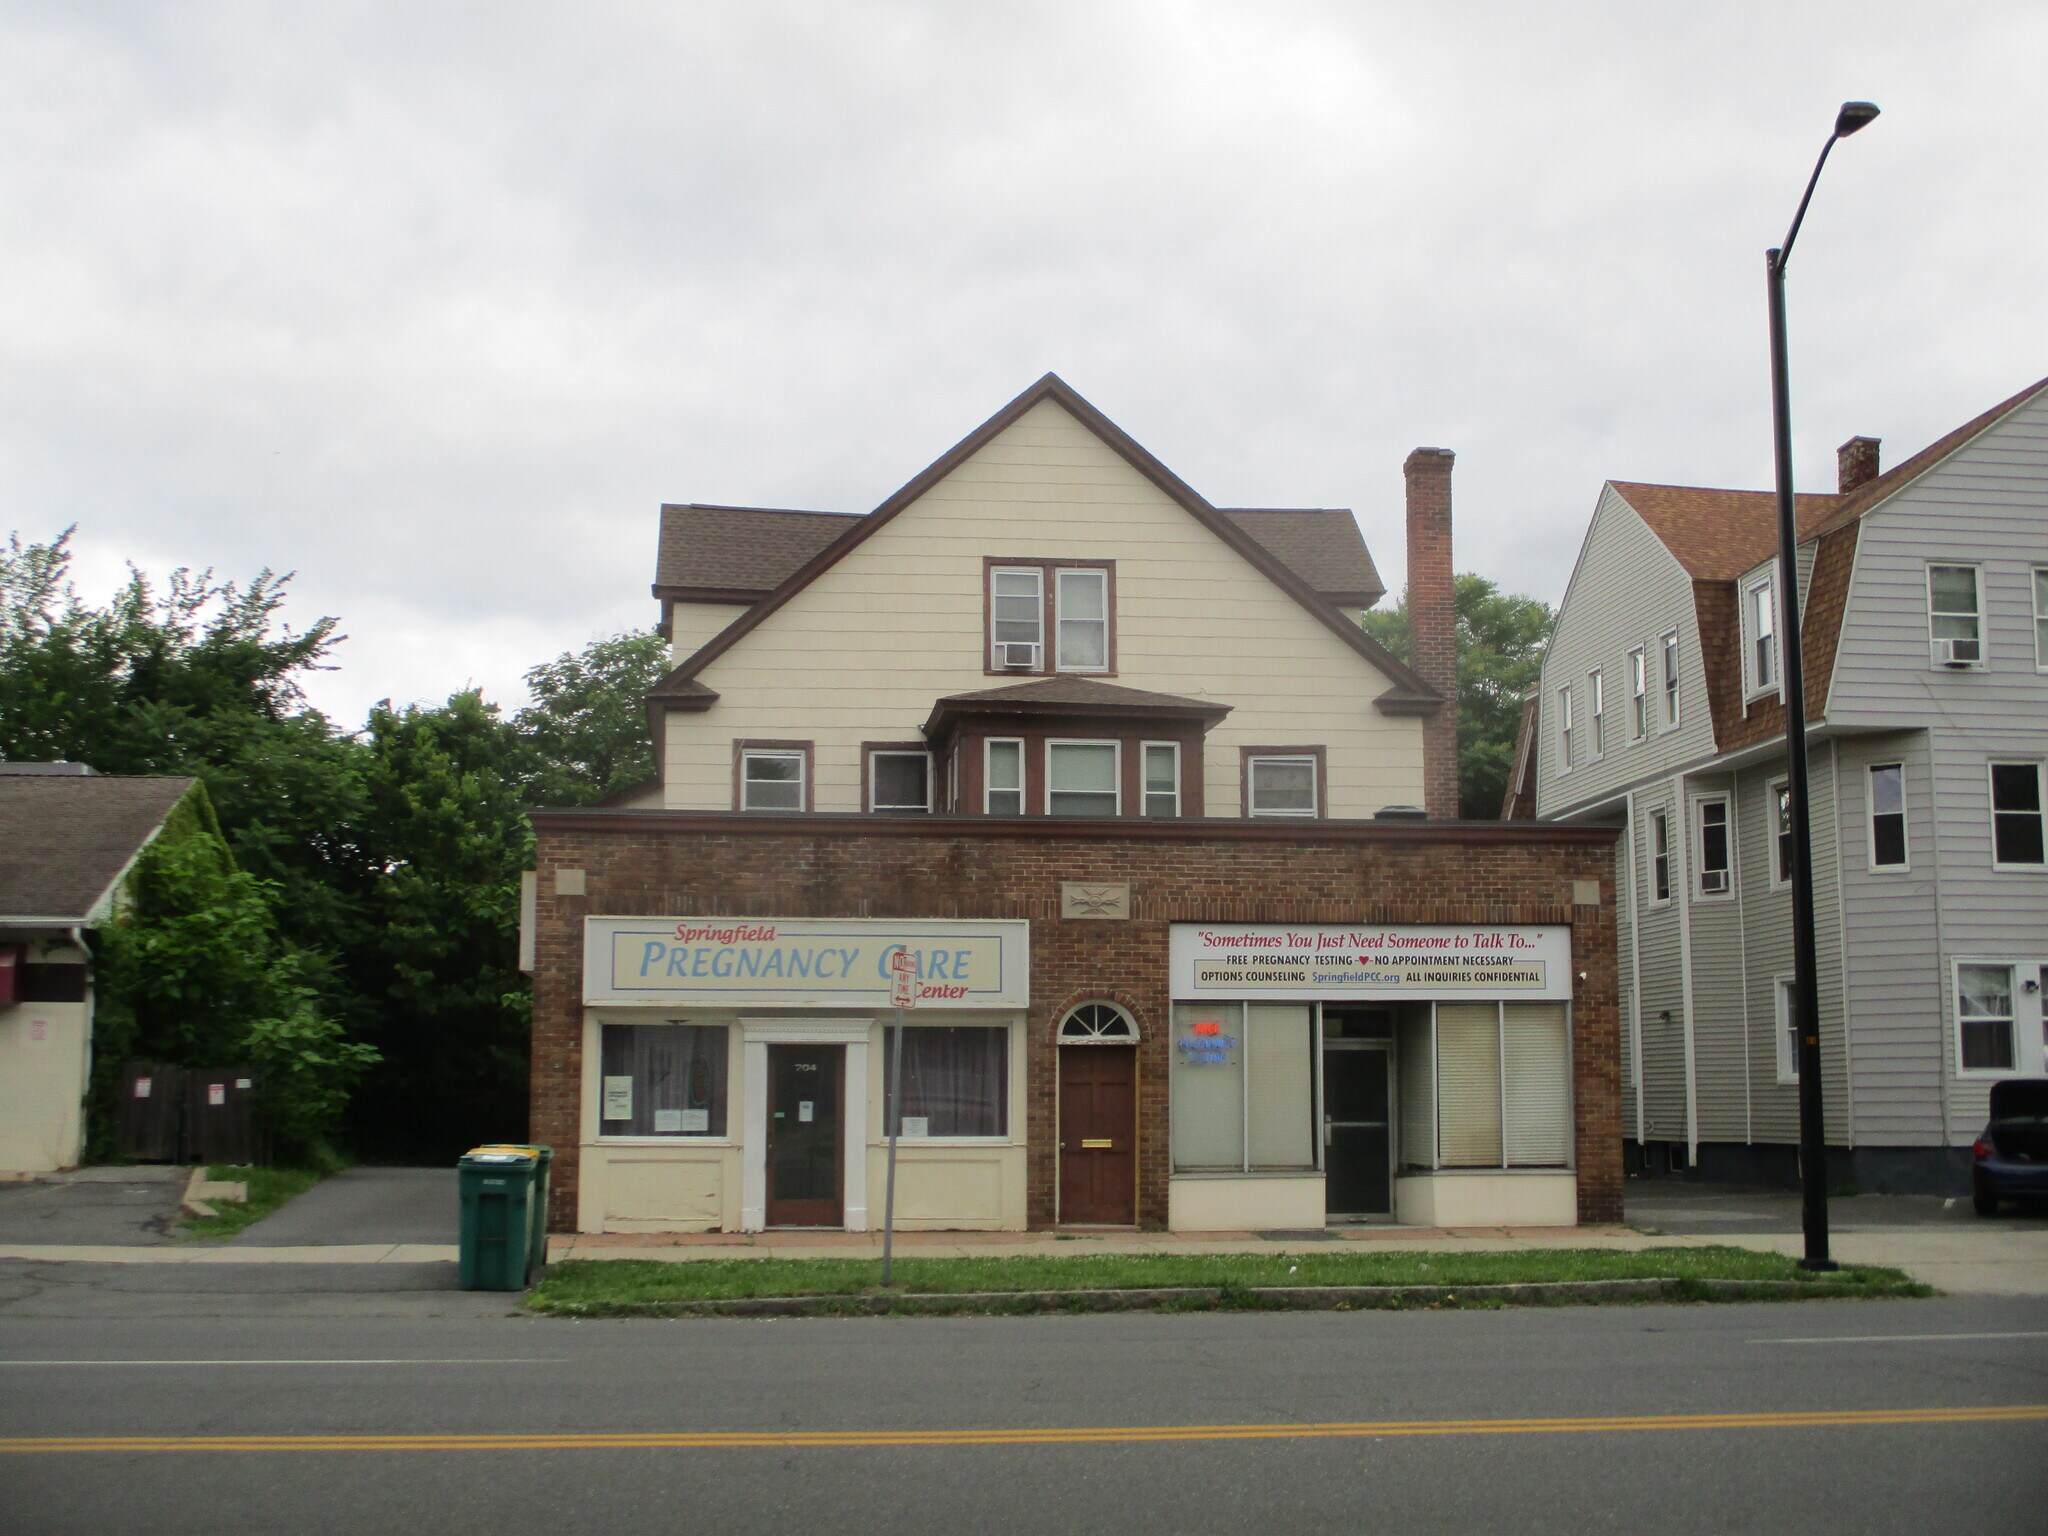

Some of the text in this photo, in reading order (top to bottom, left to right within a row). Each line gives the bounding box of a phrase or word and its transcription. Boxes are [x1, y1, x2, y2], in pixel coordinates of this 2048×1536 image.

[674, 924, 776, 944] Springfield
[1198, 931, 1282, 948] "Sometimes
[1286, 932, 1313, 948] You
[1315, 932, 1346, 951] Just
[1348, 932, 1385, 948] Need
[1387, 933, 1451, 949] Someone
[1454, 934, 1469, 949] to
[1472, 933, 1505, 949] Talk
[640, 941, 860, 979] PREGNANCY
[1226, 954, 1514, 966] FREE PREGNANCY TESTING NO APPOINTMENT NECESSARY
[1201, 971, 1540, 984] OPTIONS COUNSELING SpringfieldPCC.org ALL INQUIRIES CONFIDENTIAL
[794, 1063, 817, 1072] 704
